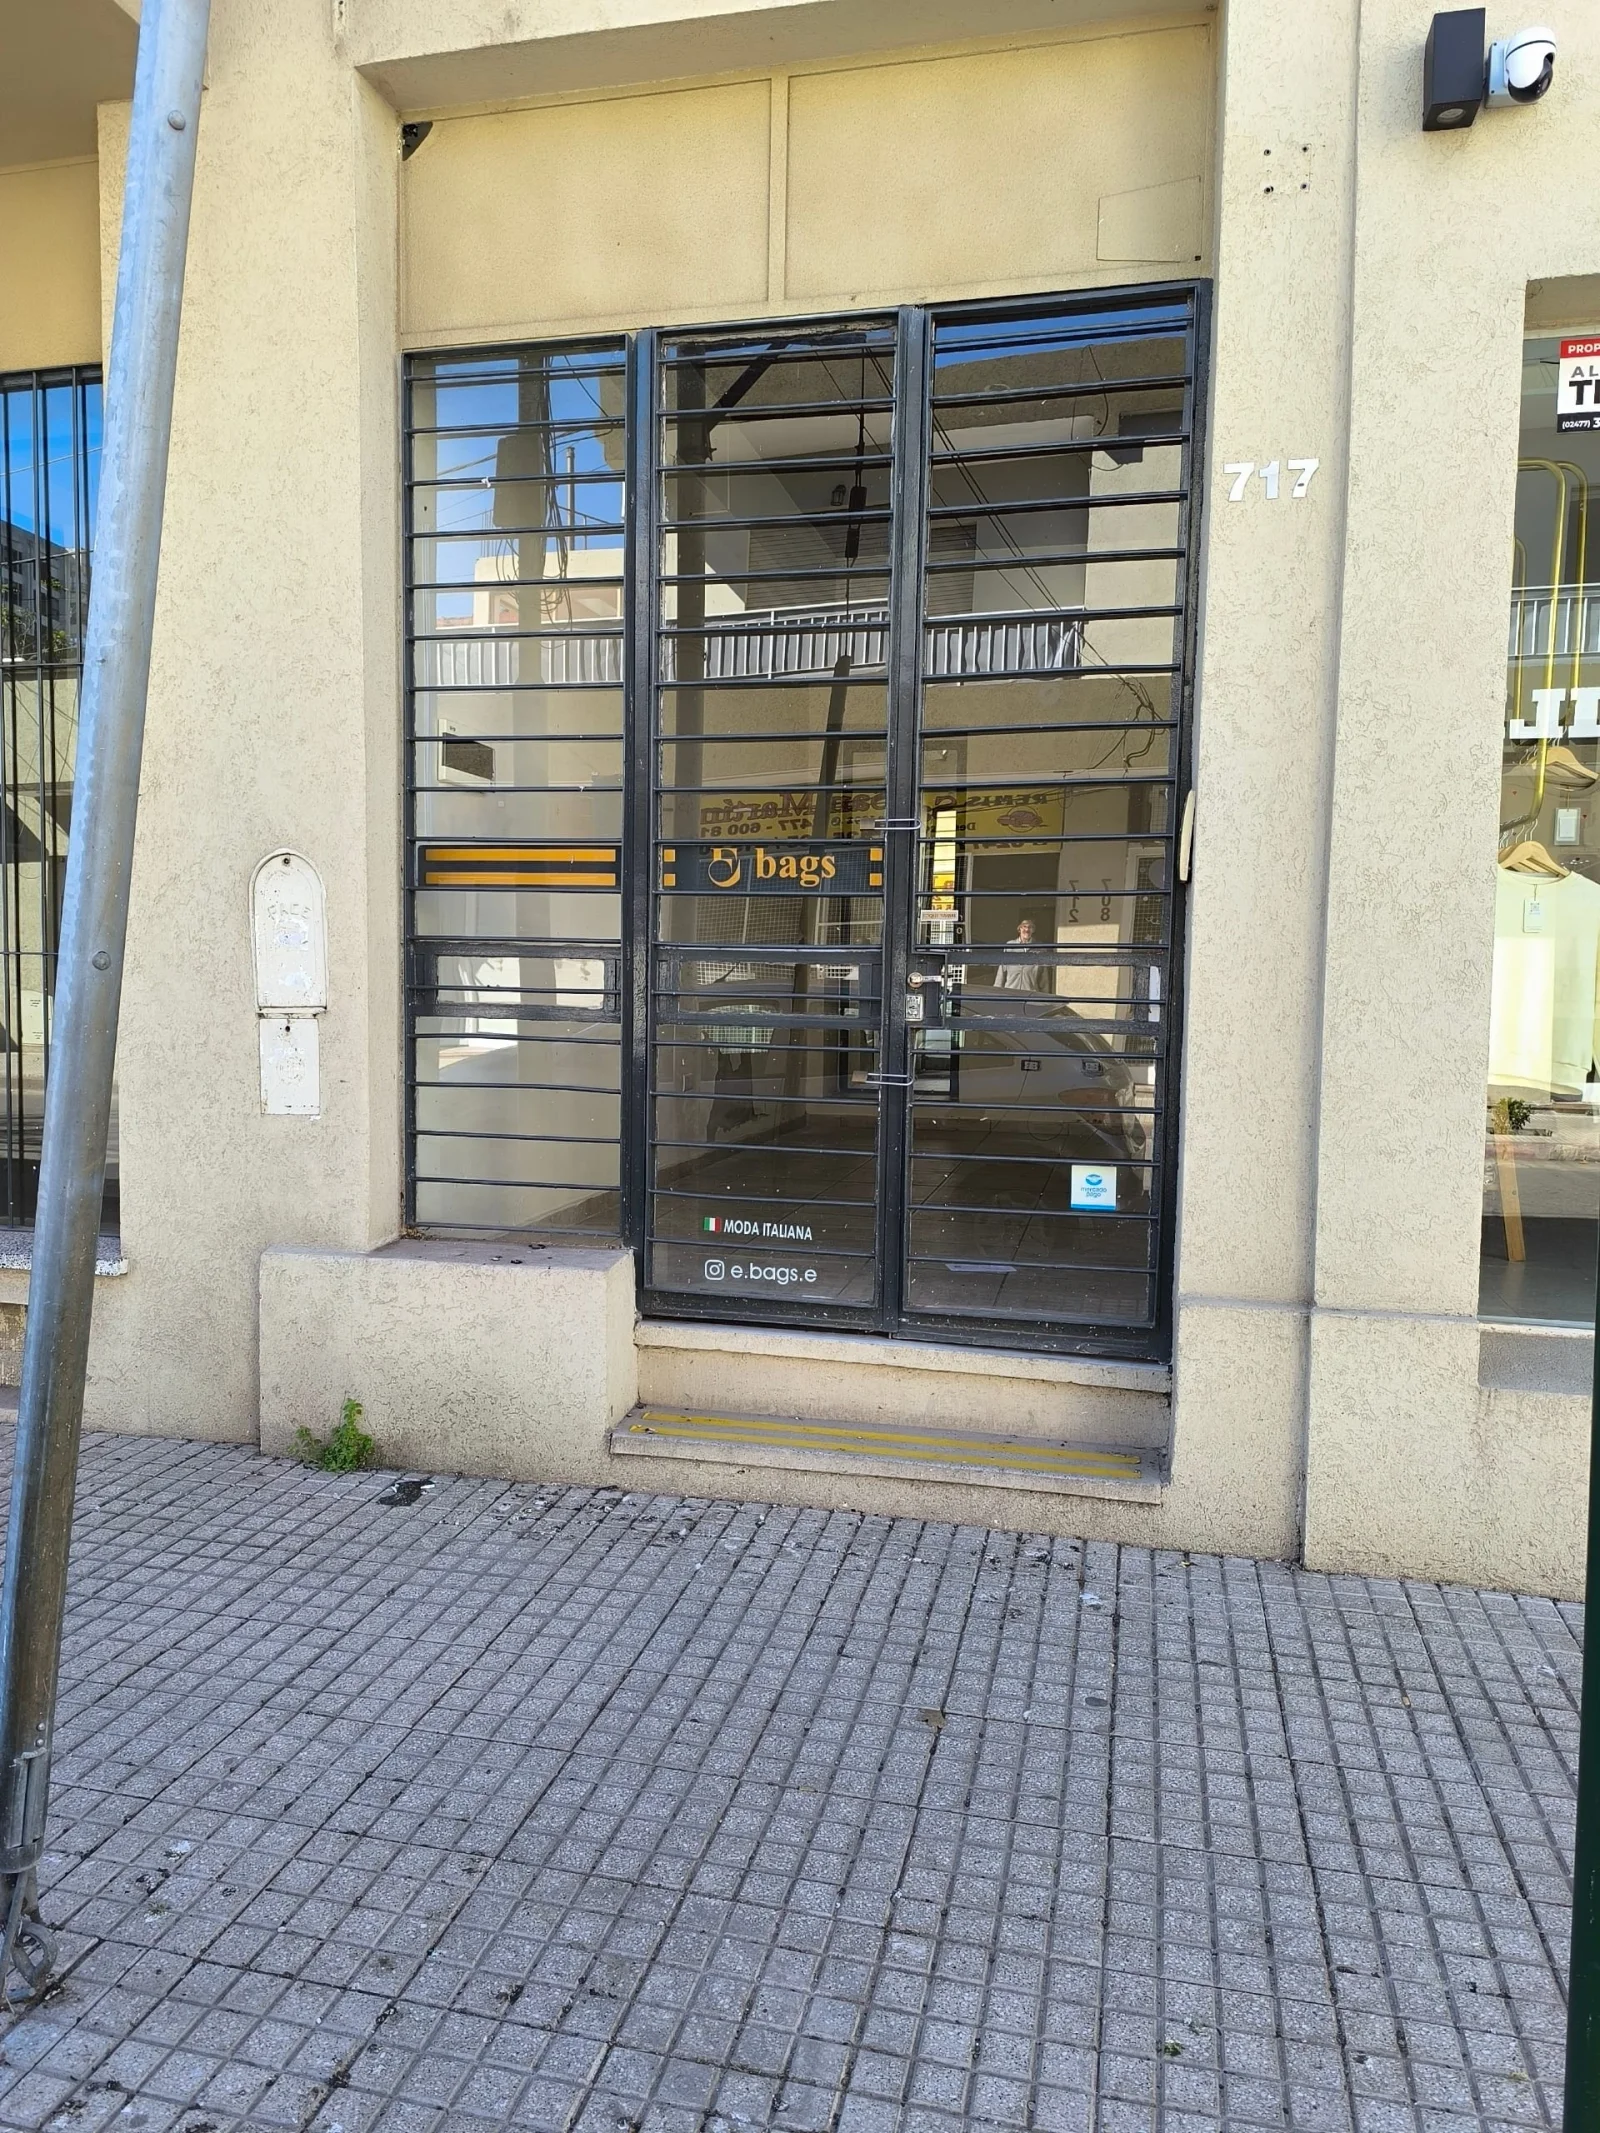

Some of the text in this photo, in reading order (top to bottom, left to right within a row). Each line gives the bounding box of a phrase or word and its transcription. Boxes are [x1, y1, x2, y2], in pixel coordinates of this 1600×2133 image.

[1562, 419, 1590, 430] (02477)
[1223, 458, 1320, 502] 717
[756, 846, 836, 888] bags
[723, 1219, 814, 1240] MODA ITALIANA
[731, 1261, 818, 1285] e.bags.e
